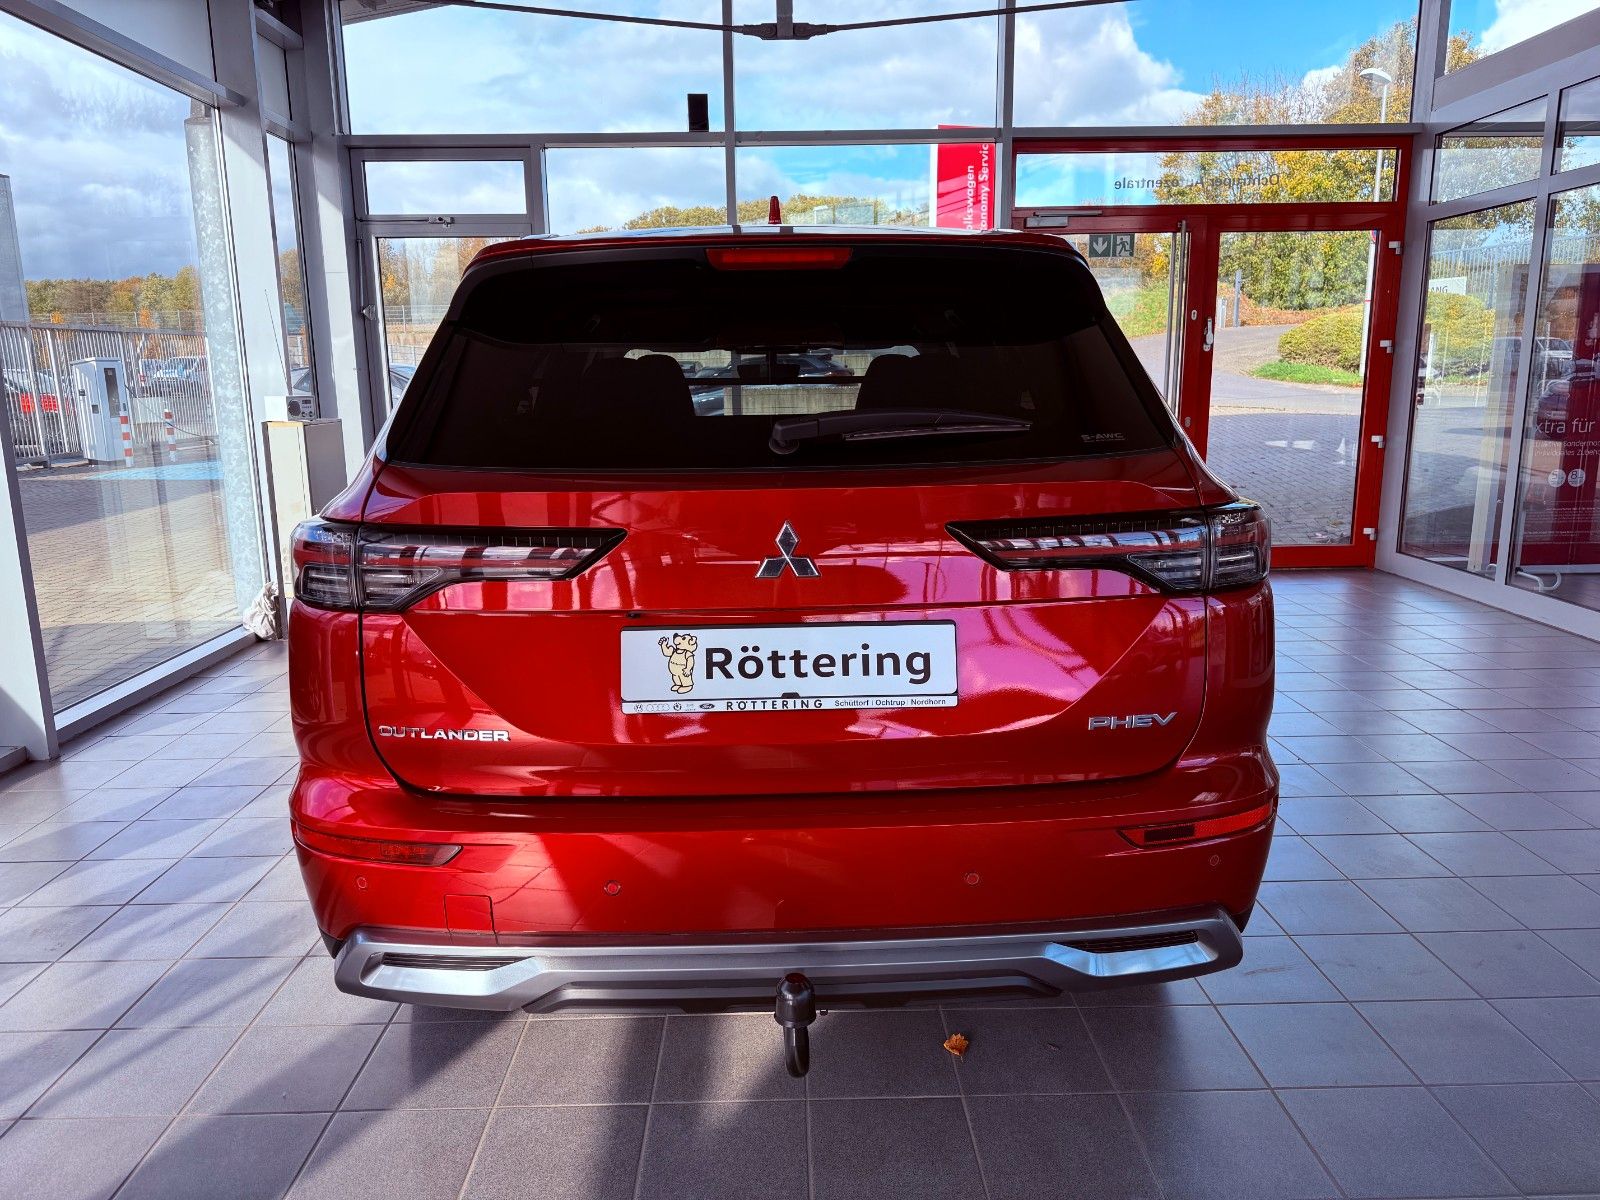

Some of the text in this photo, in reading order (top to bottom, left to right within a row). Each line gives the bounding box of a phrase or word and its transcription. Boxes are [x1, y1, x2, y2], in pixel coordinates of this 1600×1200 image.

[978, 143, 990, 230] onomy Servic
[963, 165, 976, 230] olkswagen
[1535, 418, 1596, 433] xtra für
[705, 643, 931, 685] Röttering
[726, 699, 823, 711] RÖTTERING
[875, 699, 906, 707] Ochtrup
[910, 698, 946, 706] Nordhorn
[1088, 712, 1178, 731] PHEV
[379, 725, 510, 742] OUTLANDER
